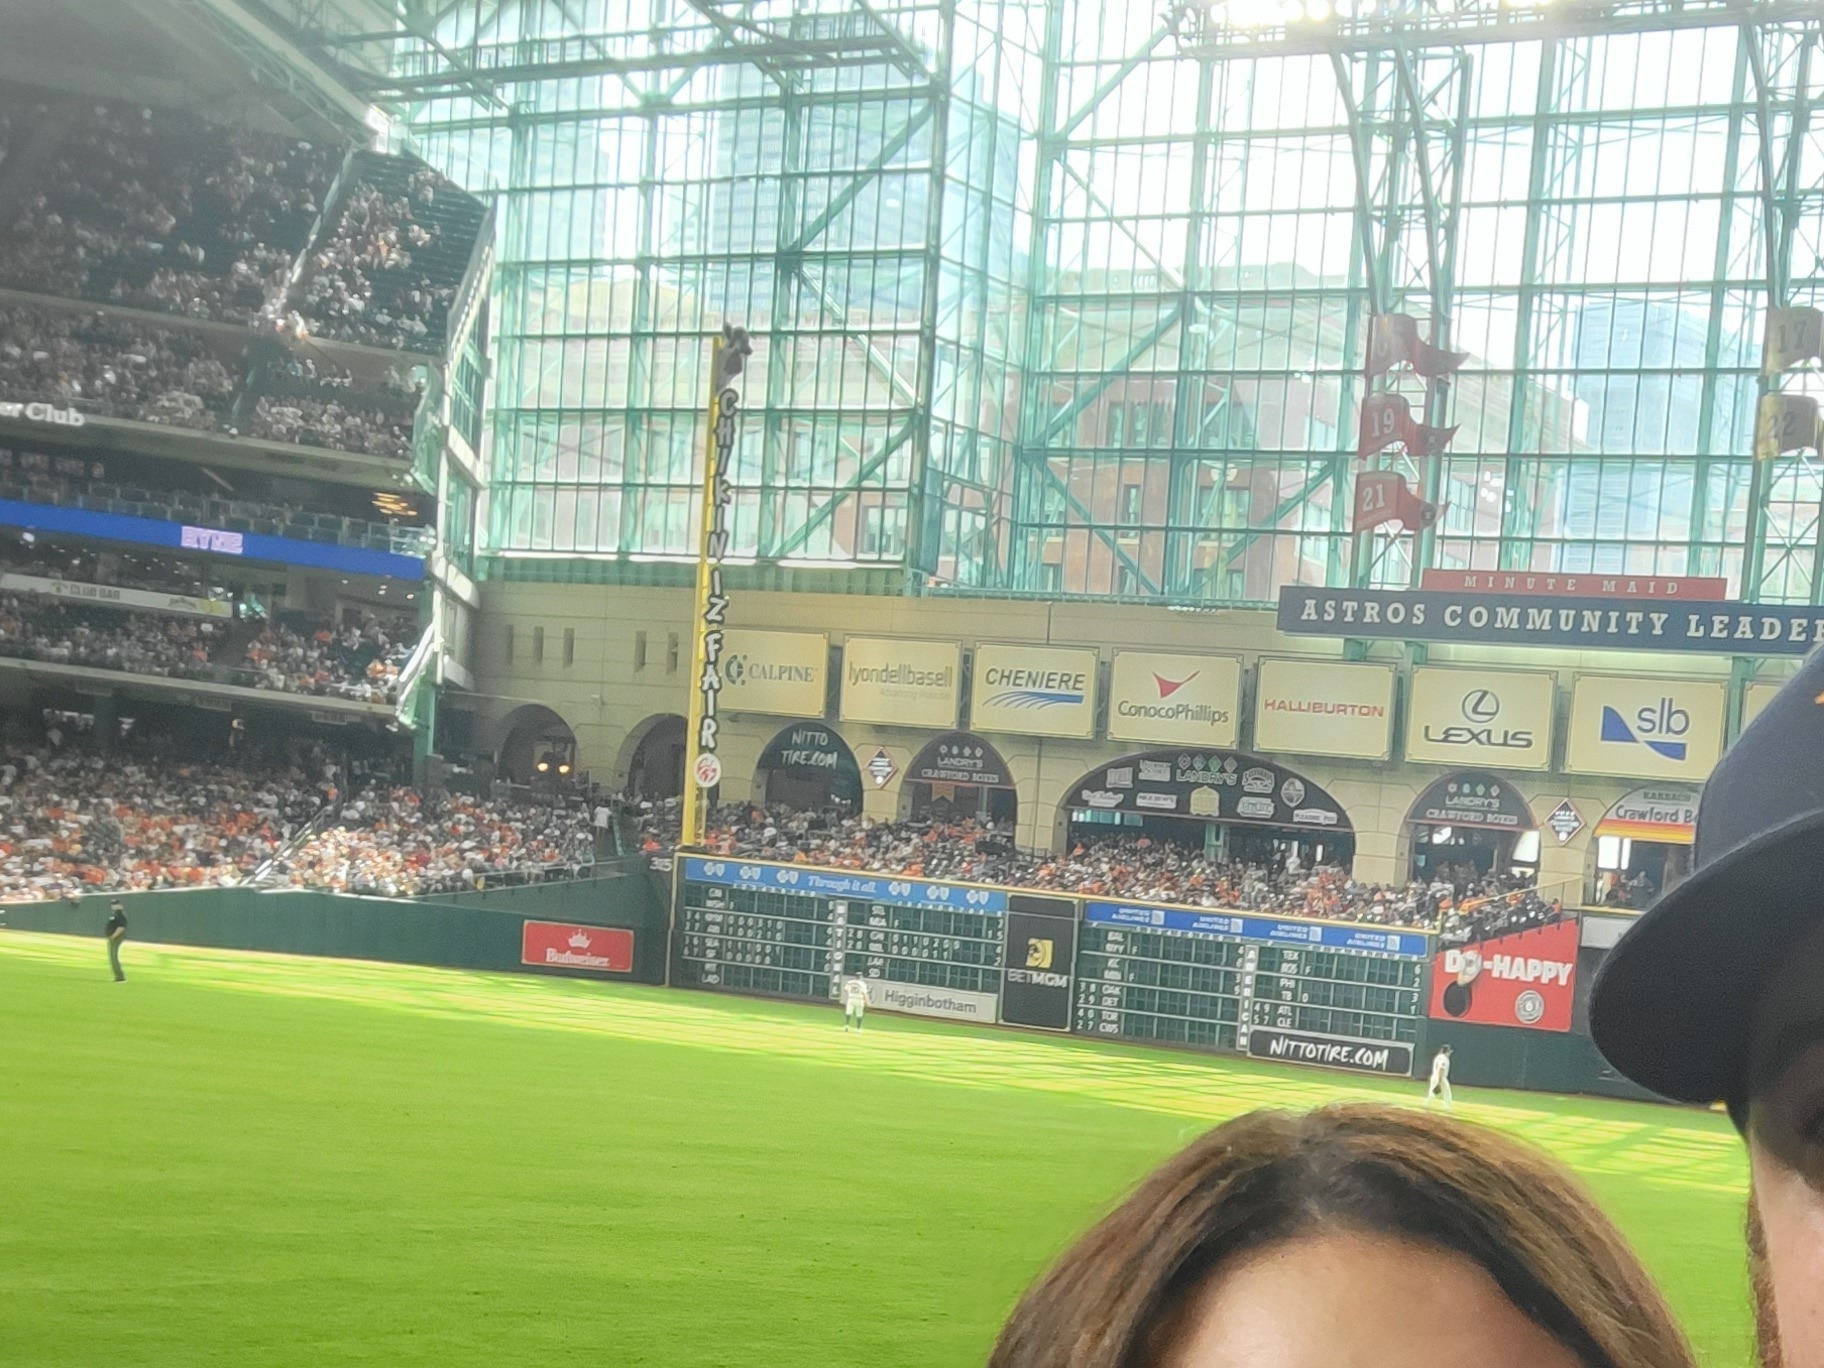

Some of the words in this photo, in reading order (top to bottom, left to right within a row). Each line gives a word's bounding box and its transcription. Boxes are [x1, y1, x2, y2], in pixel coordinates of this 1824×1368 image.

[25, 402, 85, 426] Club
[1363, 484, 1385, 511] 21
[70, 585, 97, 598] CLUB
[1463, 574, 1577, 592] MINUTE
[1603, 580, 1681, 596] MAID
[1301, 599, 1427, 625] ASTROS
[1444, 606, 1669, 637] COMMUNITY
[749, 663, 814, 683] CALPINE
[849, 660, 952, 687] lyondellbasell
[985, 667, 1086, 691] CHENIERE
[700, 631, 724, 749] FAIR
[1117, 700, 1229, 726] ConocoPhillips
[1264, 699, 1384, 718] HALLIBURTON
[1637, 697, 1690, 736] slb
[791, 728, 829, 746] NITTO
[1424, 725, 1533, 749] LEXUS
[937, 757, 983, 768] LANDRY'S
[921, 769, 969, 780] CRAWFORD
[1176, 770, 1239, 786] LANDRY'S
[1445, 795, 1500, 809] LANDRY'S
[1426, 809, 1484, 822] CRAWFORD
[1486, 814, 1518, 825] BOXES
[1616, 805, 1679, 823] Crawford
[808, 875, 851, 891] Through
[545, 947, 610, 967] Budweiser
[1282, 950, 1299, 960] TEX
[1007, 968, 1069, 988] BETMGM
[1279, 978, 1296, 989] PHI
[884, 990, 977, 1014] Higginbotham
[1277, 1005, 1293, 1016] ATL
[1276, 1017, 1292, 1028] CLE
[1270, 1035, 1389, 1070] NITTOTIRE.COM
